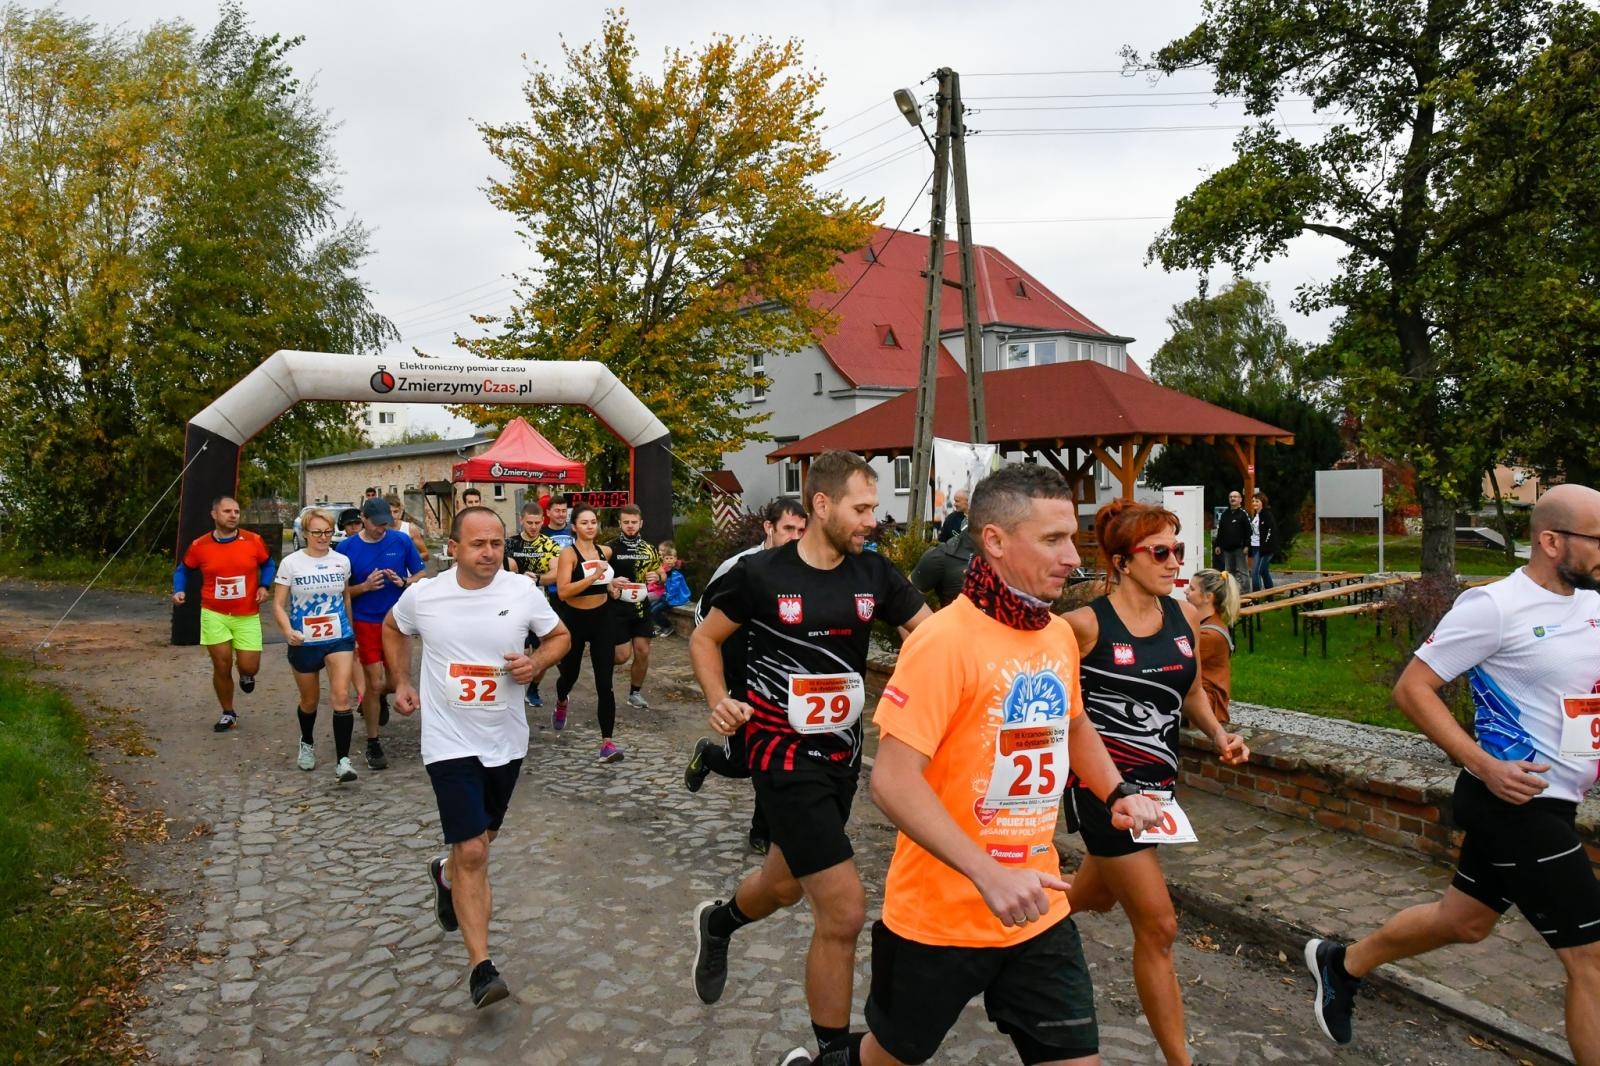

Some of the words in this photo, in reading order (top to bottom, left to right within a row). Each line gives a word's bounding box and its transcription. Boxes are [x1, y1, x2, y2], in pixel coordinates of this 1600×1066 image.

[400, 362, 464, 373] Elektroniczny
[467, 365, 498, 373] pomiar
[398, 377, 532, 396] ZmierzymyCzas.pl
[220, 585, 239, 596] 31
[631, 590, 638, 600] 5
[311, 623, 333, 638] 22
[459, 678, 497, 702] 32
[805, 694, 851, 725] 29
[1054, 728, 1065, 736] bieg
[1008, 752, 1056, 797] 25
